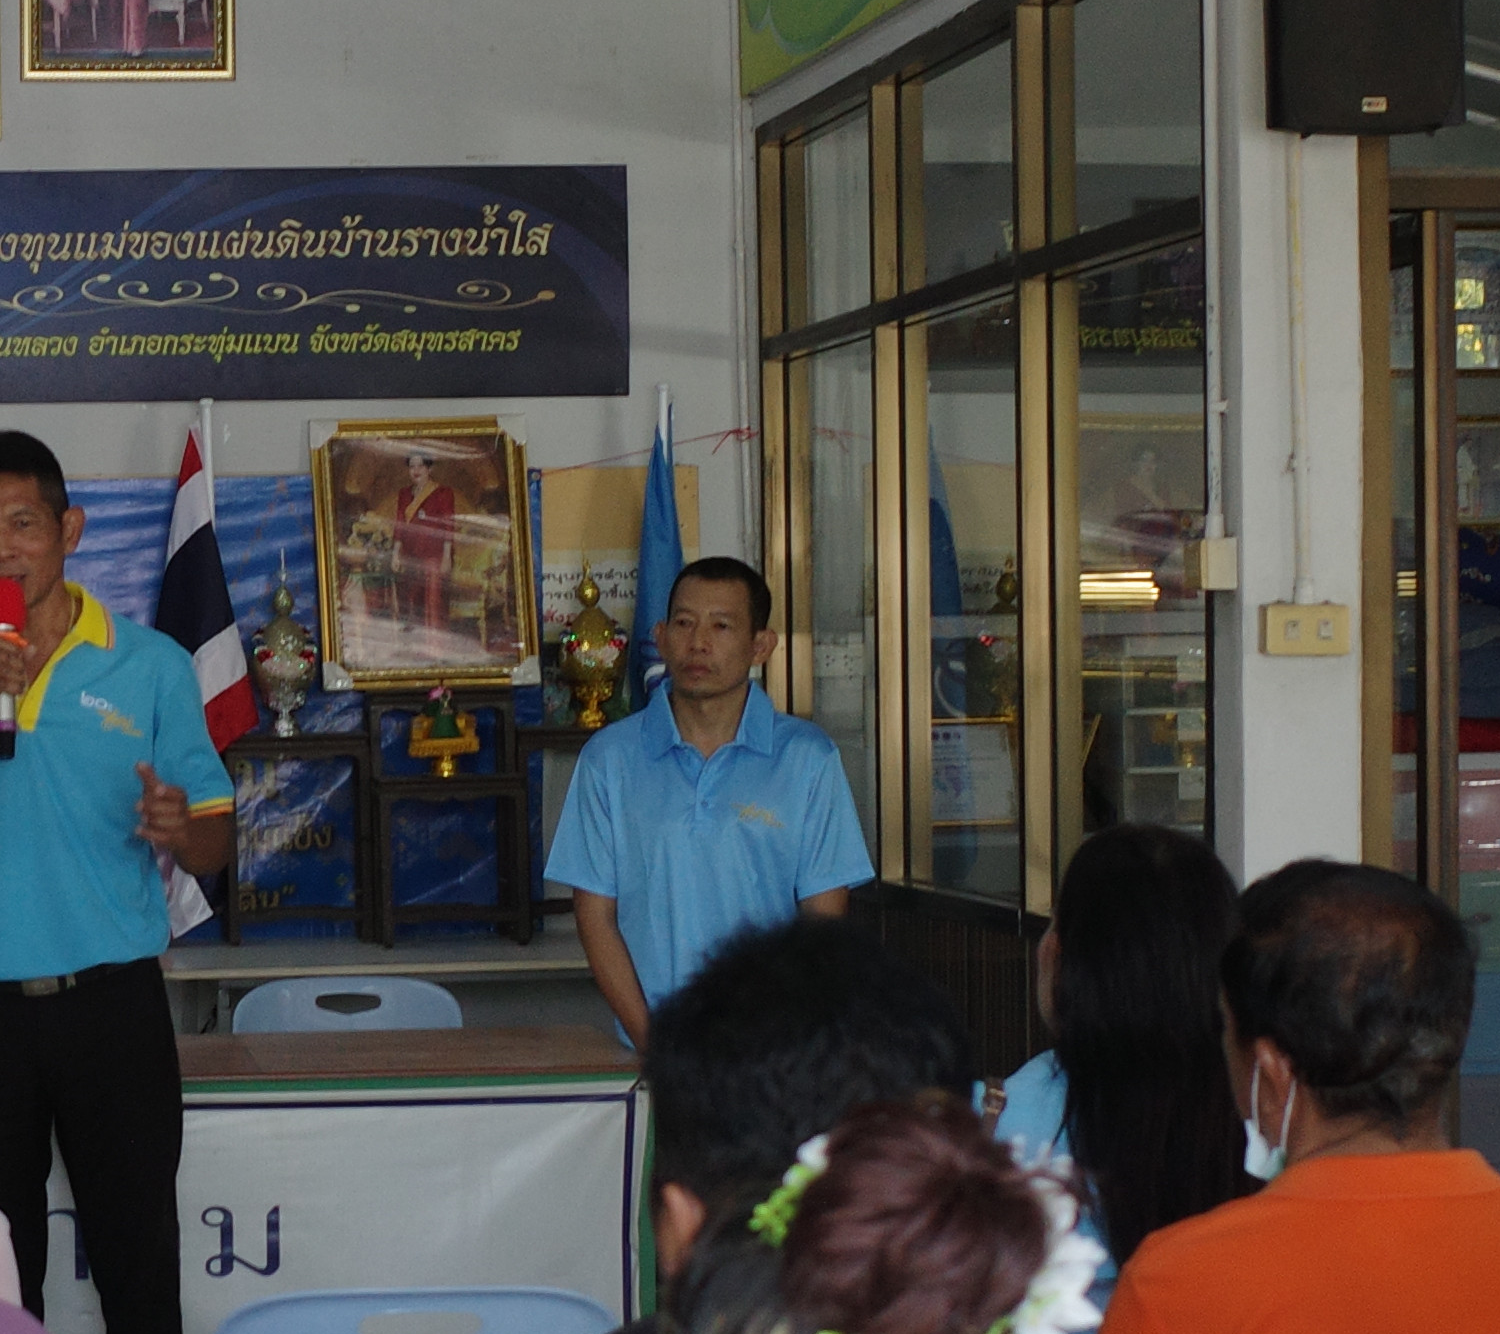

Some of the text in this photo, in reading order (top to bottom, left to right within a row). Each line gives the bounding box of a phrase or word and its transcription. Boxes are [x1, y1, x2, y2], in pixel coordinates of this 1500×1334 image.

[88, 326, 300, 364] อำเภอกระทุ่มแบน
[308, 323, 523, 362] จังหวัดสมุทรสาคร
